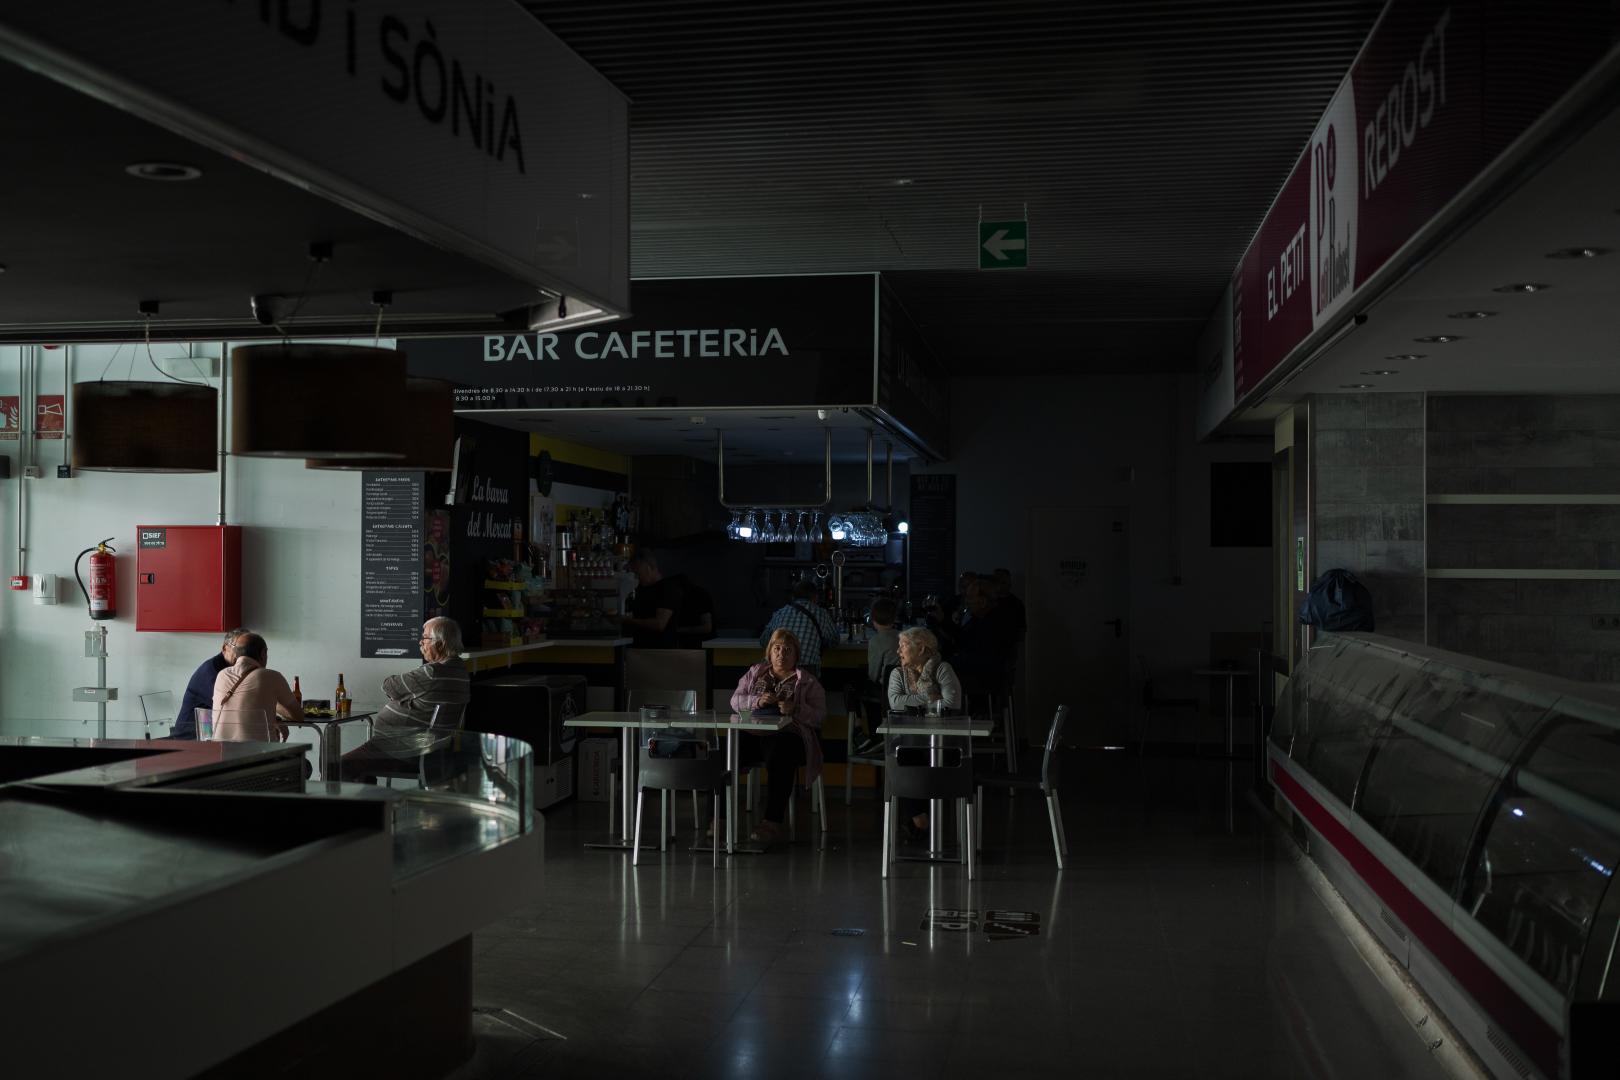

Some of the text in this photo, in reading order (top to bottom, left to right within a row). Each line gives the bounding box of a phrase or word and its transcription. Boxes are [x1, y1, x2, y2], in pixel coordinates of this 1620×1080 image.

[1364, 5, 1451, 200] REBOST
[1267, 265, 1279, 321] EL
[483, 333, 560, 362] BAR
[471, 474, 508, 504] La barra
[467, 511, 481, 537] del
[482, 512, 512, 539] Mercat
